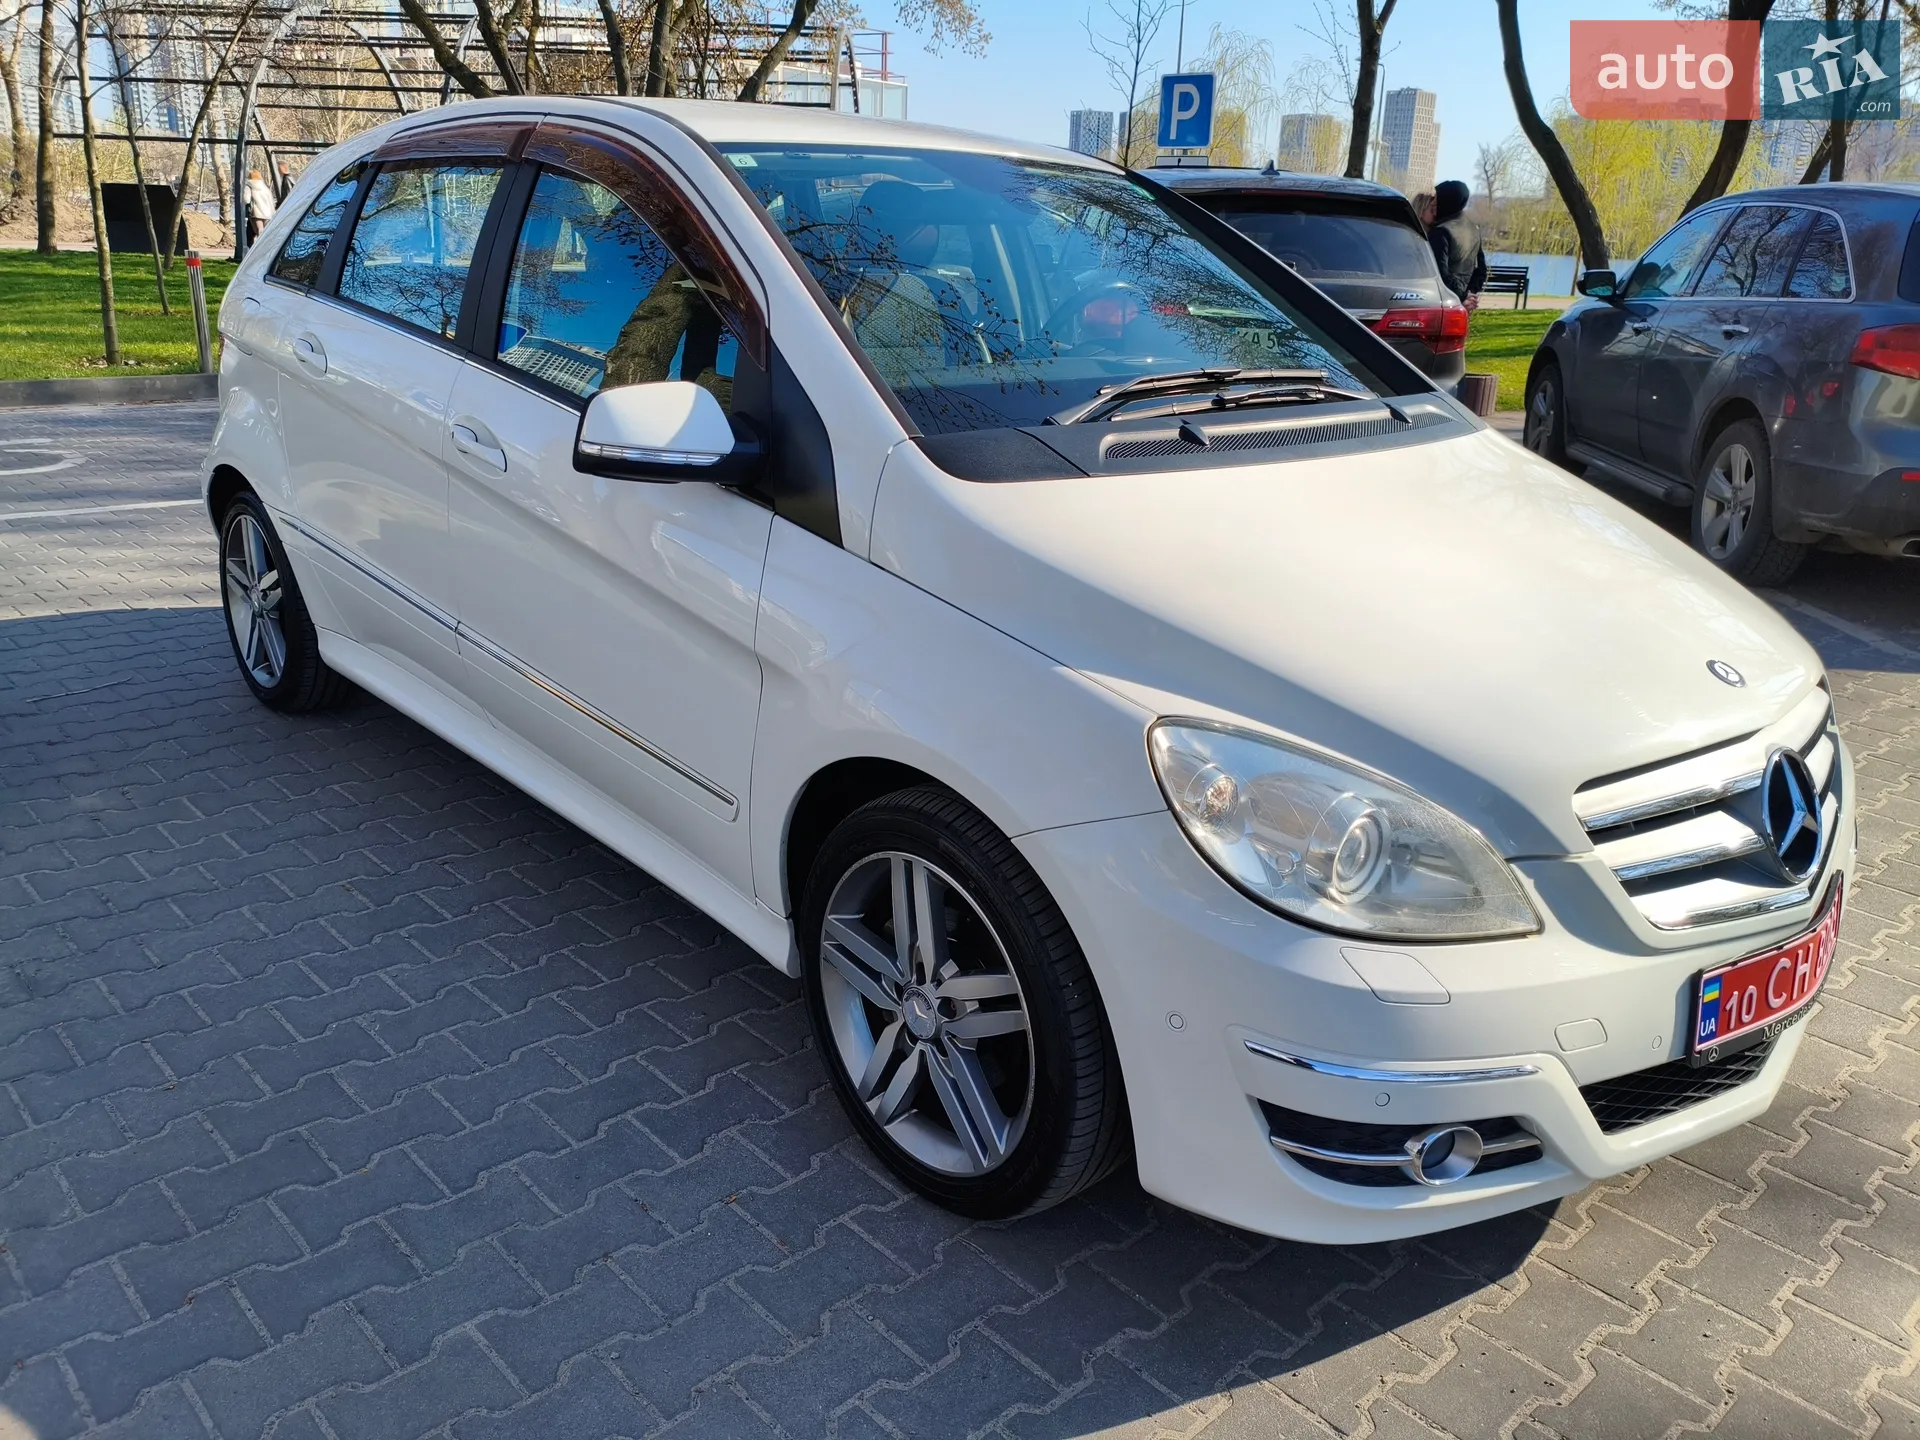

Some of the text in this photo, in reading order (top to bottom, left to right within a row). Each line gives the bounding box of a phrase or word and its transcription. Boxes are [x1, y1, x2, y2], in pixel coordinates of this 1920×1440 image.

[1169, 83, 1200, 140] P
[1392, 292, 1427, 301] MDX
[1725, 942, 1814, 1030] 10 CH
[1700, 1017, 1716, 1037] UA
